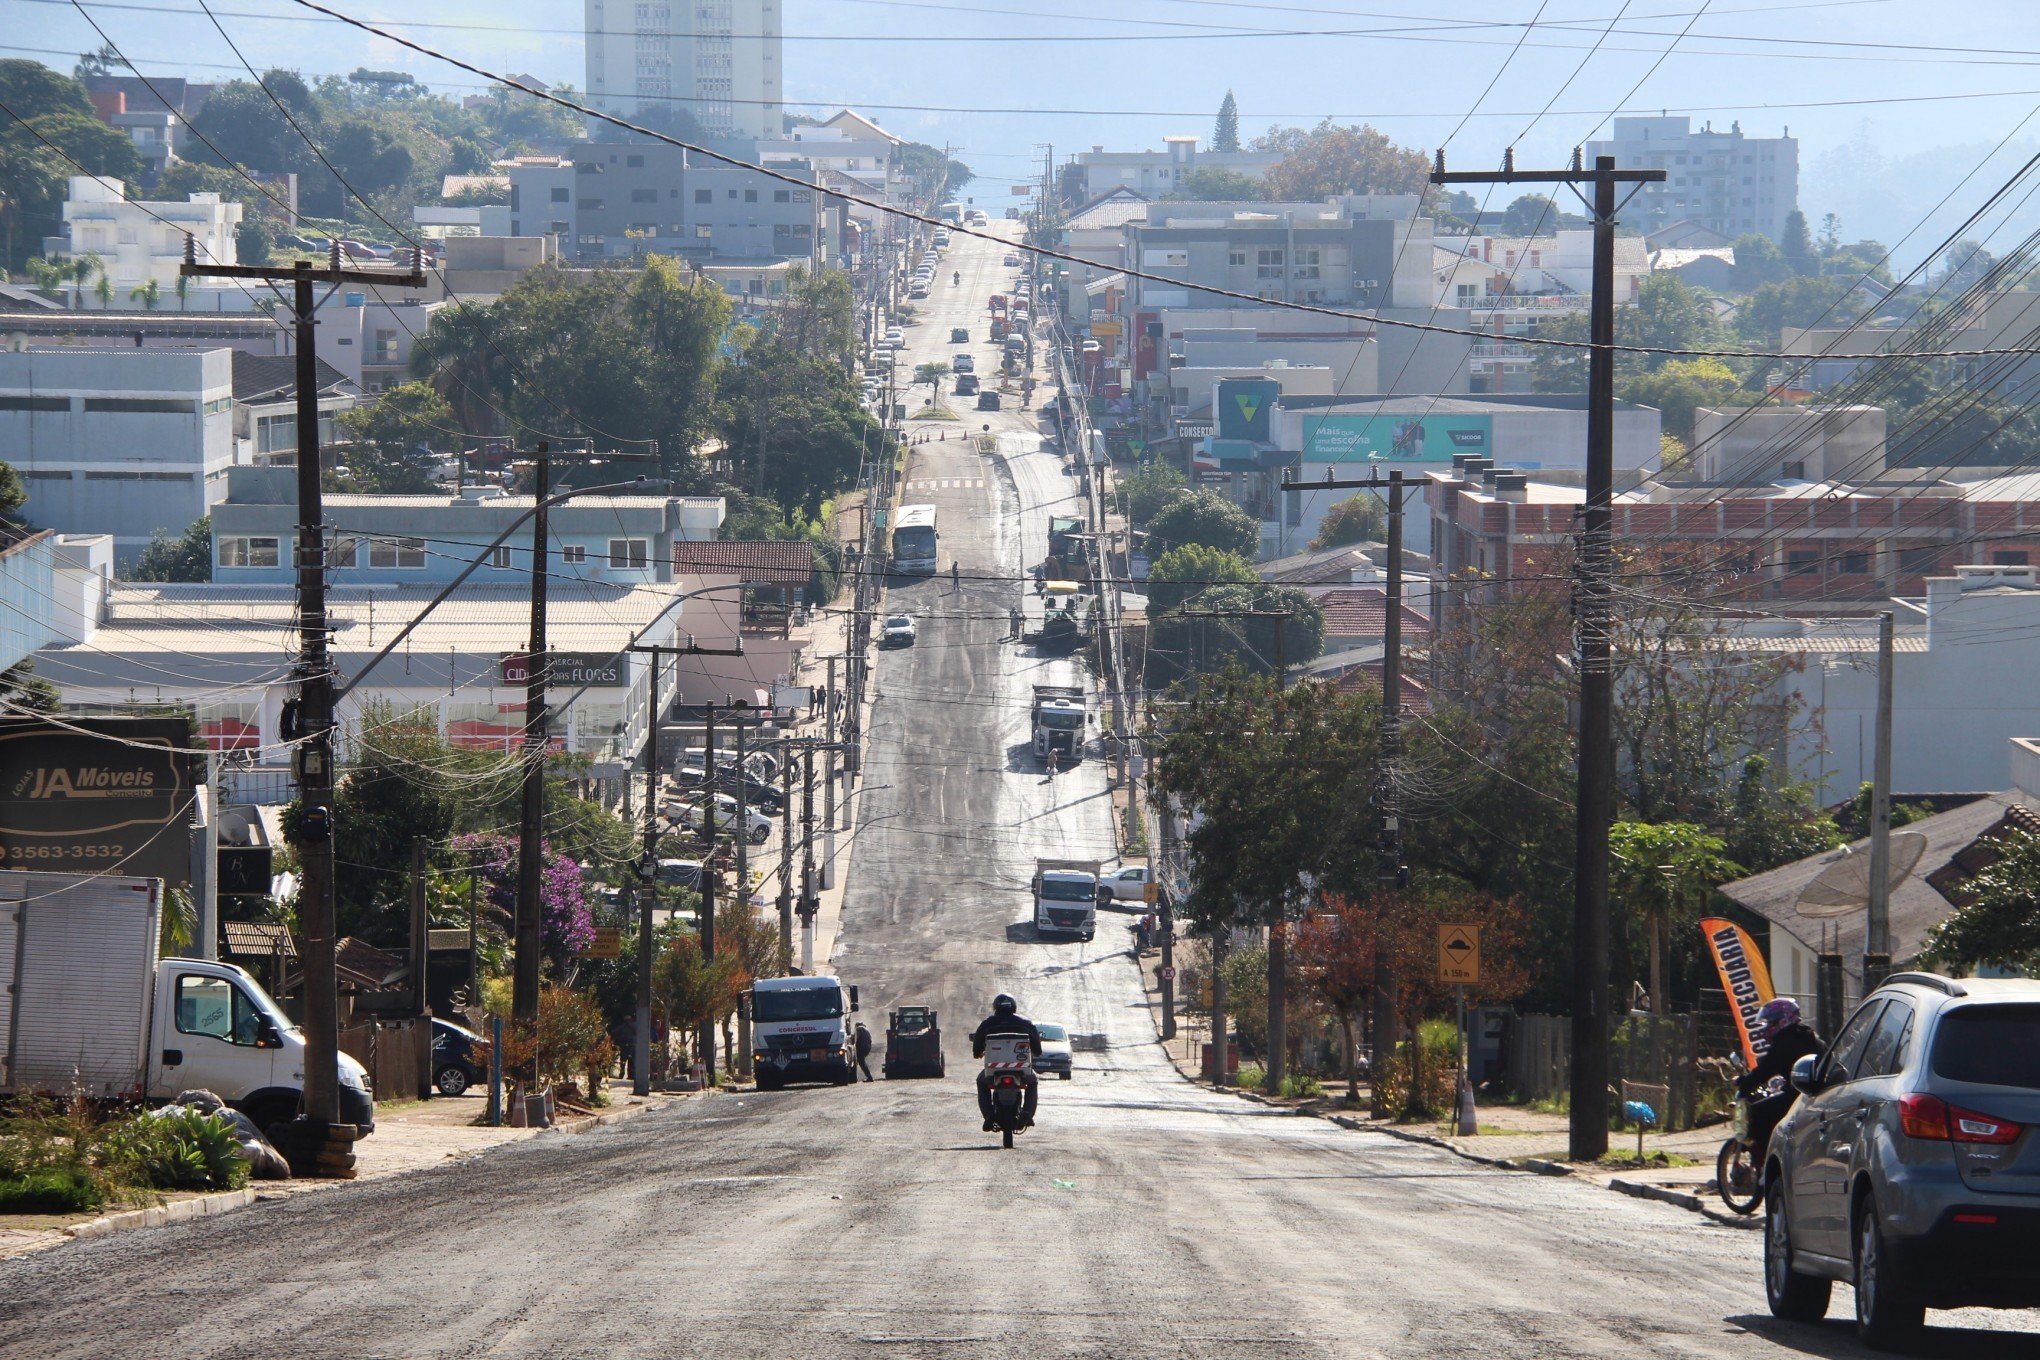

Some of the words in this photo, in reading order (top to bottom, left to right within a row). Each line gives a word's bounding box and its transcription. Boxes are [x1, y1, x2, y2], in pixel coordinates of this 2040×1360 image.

[1316, 426, 1341, 435] Mais
[12, 769, 34, 797] LOJAS
[30, 768, 77, 798] JA
[76, 766, 155, 787] Móveis
[105, 788, 154, 797] Conceito
[11, 845, 124, 859] 3563-3532
[1451, 969, 1463, 977] 150
[1703, 925, 1774, 1058] GROPECUÁRIA
[202, 1007, 225, 1029] 2565
